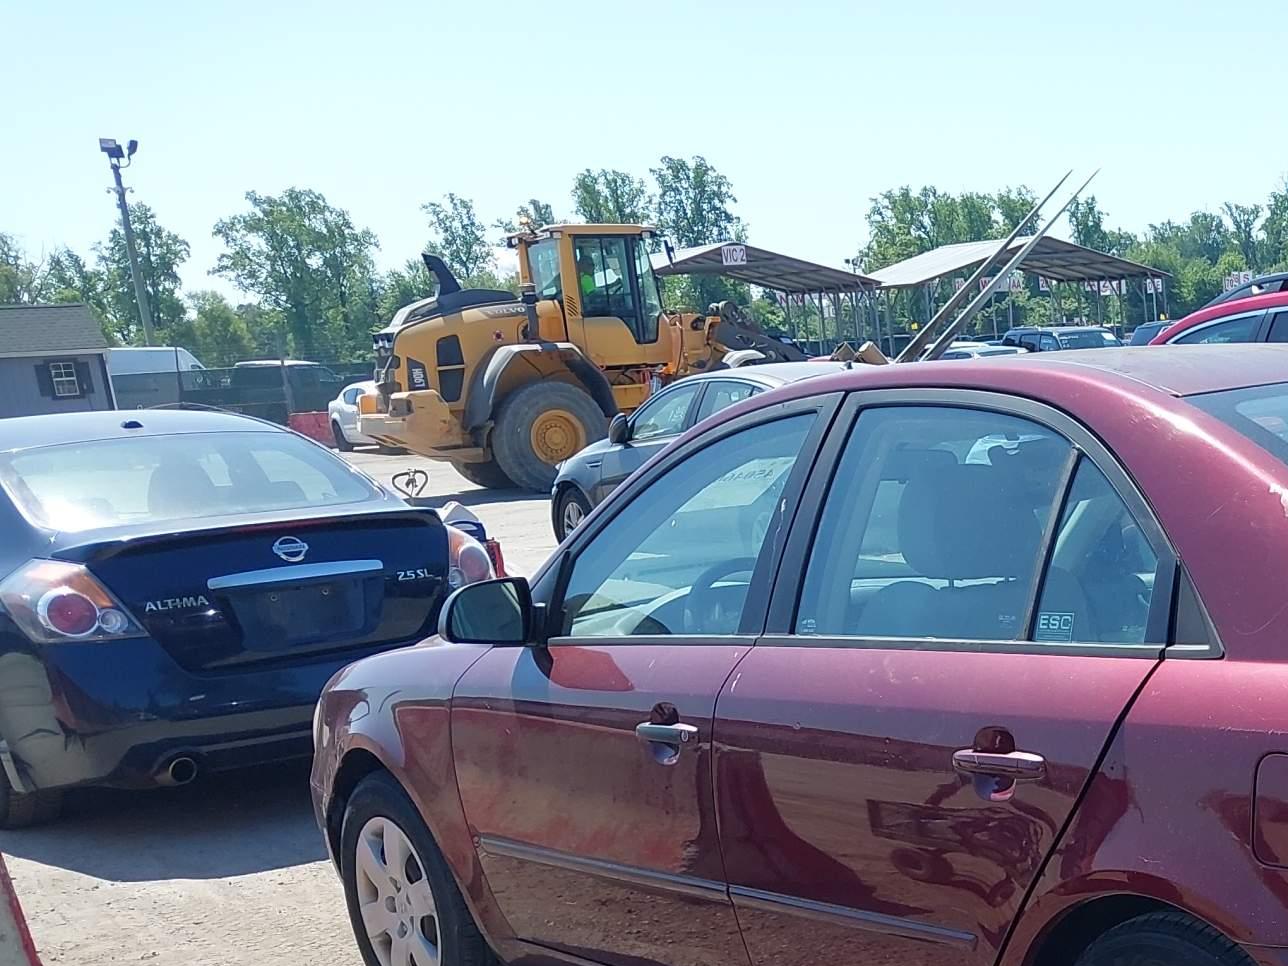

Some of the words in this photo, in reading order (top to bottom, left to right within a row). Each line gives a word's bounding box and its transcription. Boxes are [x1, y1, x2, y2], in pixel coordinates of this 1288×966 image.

[722, 248, 738, 264] VIC
[739, 248, 746, 262] 2
[411, 368, 425, 387] L90H
[416, 568, 434, 579] SL
[145, 595, 209, 612] ALTIMA
[1039, 615, 1072, 629] ESC
